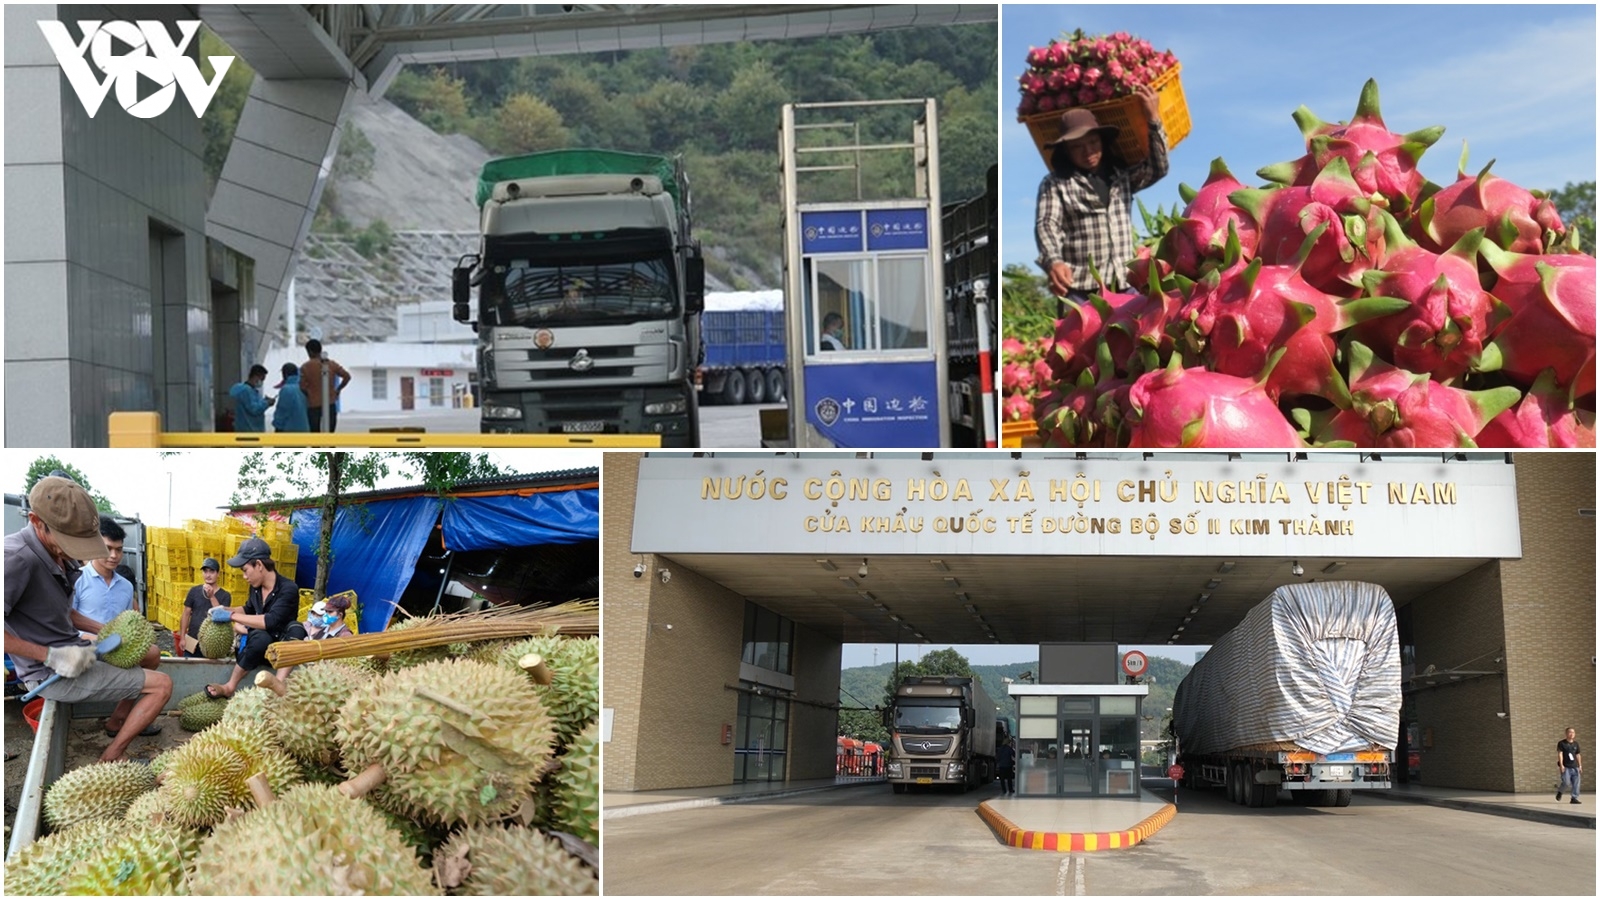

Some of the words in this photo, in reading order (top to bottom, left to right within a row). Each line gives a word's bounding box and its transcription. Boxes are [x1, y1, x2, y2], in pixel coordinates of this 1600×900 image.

[701, 469, 789, 501] NƯỚC
[803, 470, 892, 507] CỘNG
[907, 471, 973, 501] HÒA
[990, 471, 1035, 502] XÃ
[1050, 472, 1101, 508] HỘI
[1117, 469, 1179, 503] CHỦ
[1195, 473, 1291, 504] NGHĨA
[1305, 474, 1372, 510] VIỆT
[1388, 481, 1458, 505] NAM
[803, 508, 851, 533] CỬA
[932, 509, 996, 533] QUỐC
[1007, 509, 1036, 534] TẾ
[1041, 512, 1122, 535] ĐƯỜNG
[1130, 513, 1160, 540] BỘ
[1169, 510, 1200, 535] SỐ
[1208, 517, 1221, 536] II
[1230, 517, 1270, 536] KIM
[1278, 513, 1354, 536] THÀNH
